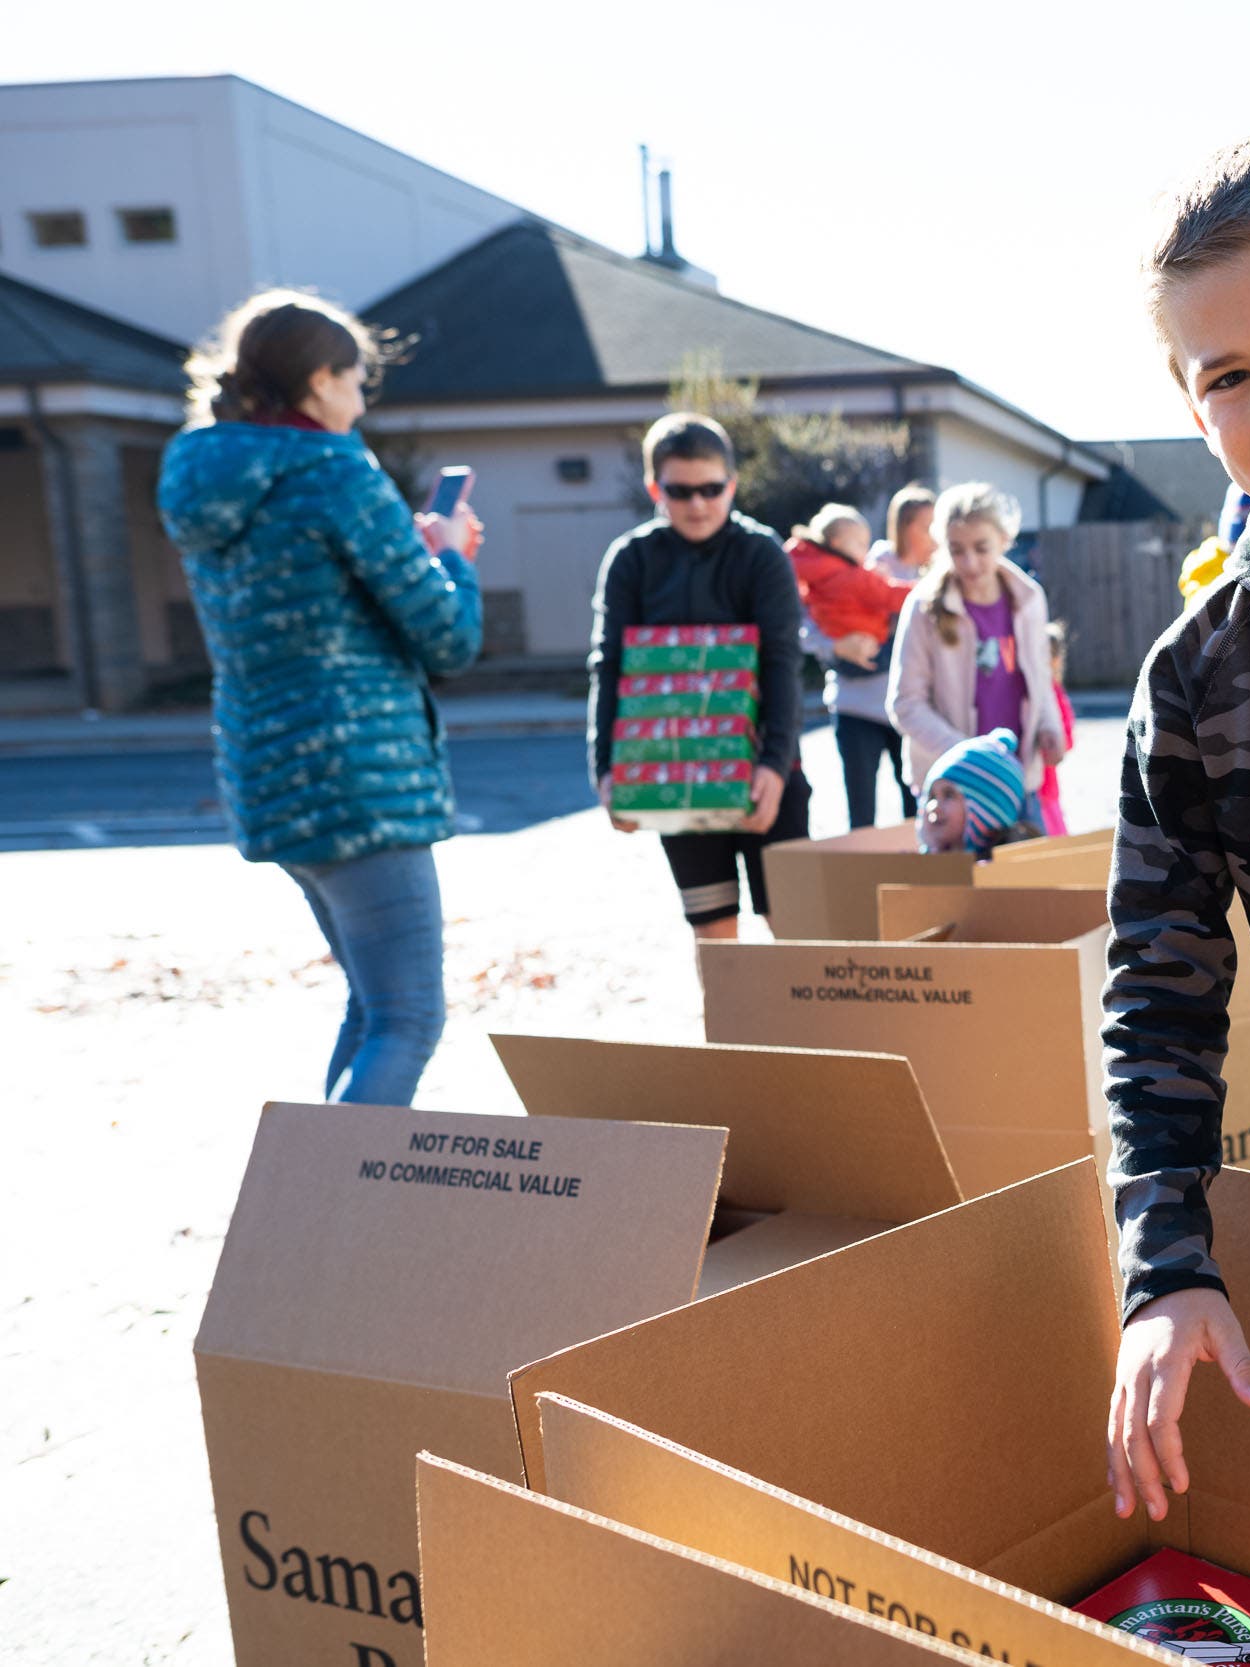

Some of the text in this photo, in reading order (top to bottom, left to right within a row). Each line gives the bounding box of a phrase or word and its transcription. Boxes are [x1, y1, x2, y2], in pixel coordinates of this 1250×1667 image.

[825, 965, 857, 979] NOT
[894, 966, 933, 981] SALE
[791, 987, 973, 1004] NO COMMERCIAL VALUE
[409, 1132, 543, 1161] NOT FOR SALE
[359, 1160, 582, 1197] NO COMMERCIAL VALUE
[790, 1554, 856, 1608] NOT
